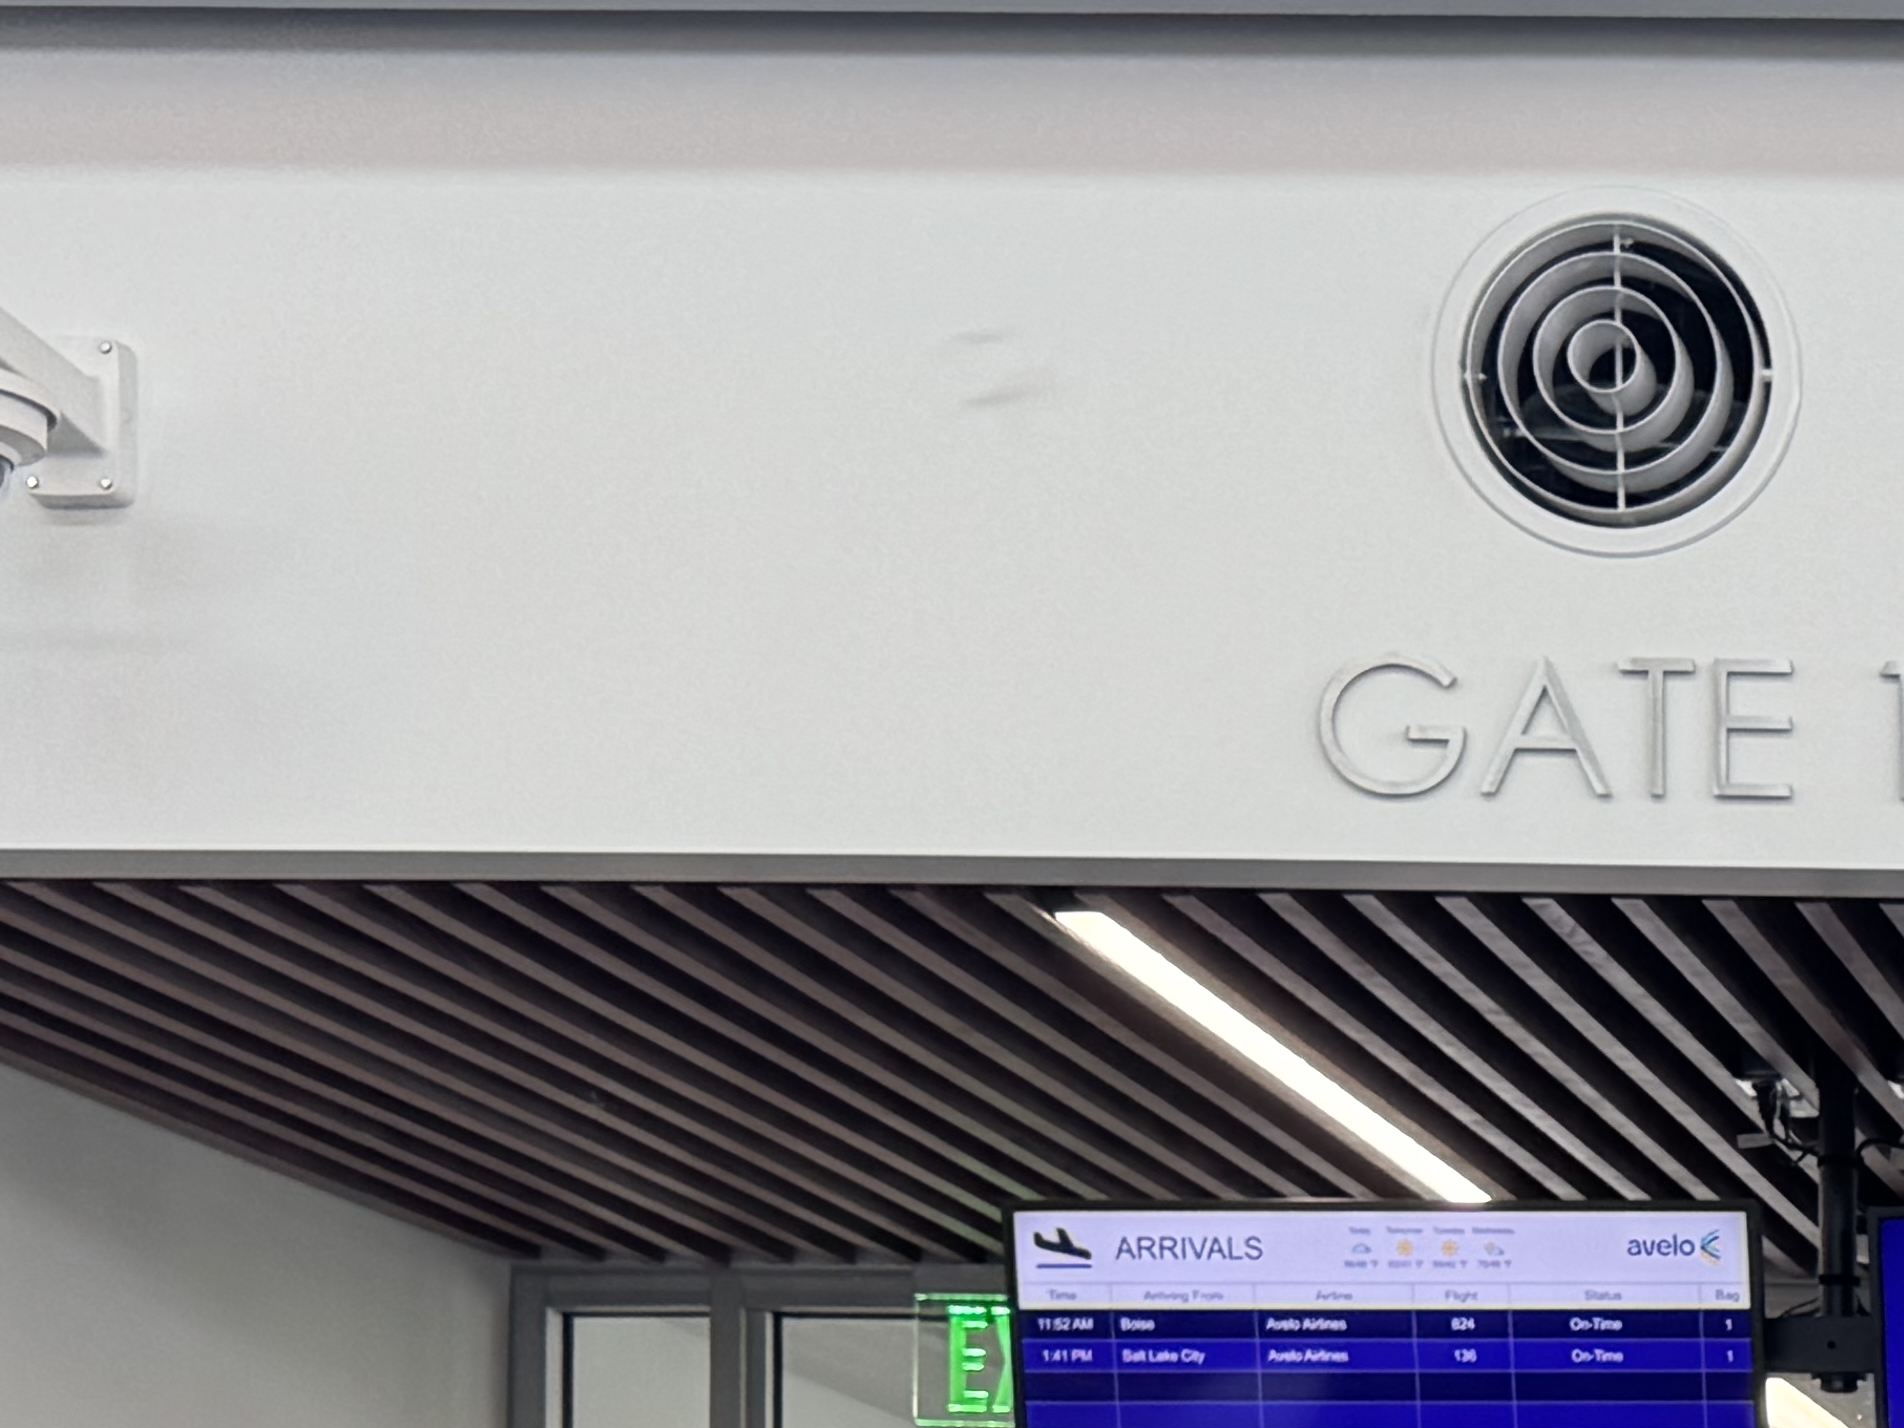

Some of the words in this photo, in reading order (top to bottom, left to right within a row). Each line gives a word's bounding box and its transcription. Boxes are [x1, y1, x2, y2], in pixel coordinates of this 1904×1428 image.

[1318, 653, 1793, 799] GATE
[1115, 1236, 1263, 1261] ARRIVALS
[1626, 1234, 1695, 1257] avelo
[1072, 1317, 1094, 1331] AM
[1569, 1317, 1623, 1332] On-Time
[1071, 1348, 1093, 1363] PM
[1571, 1348, 1624, 1363] On-Time
